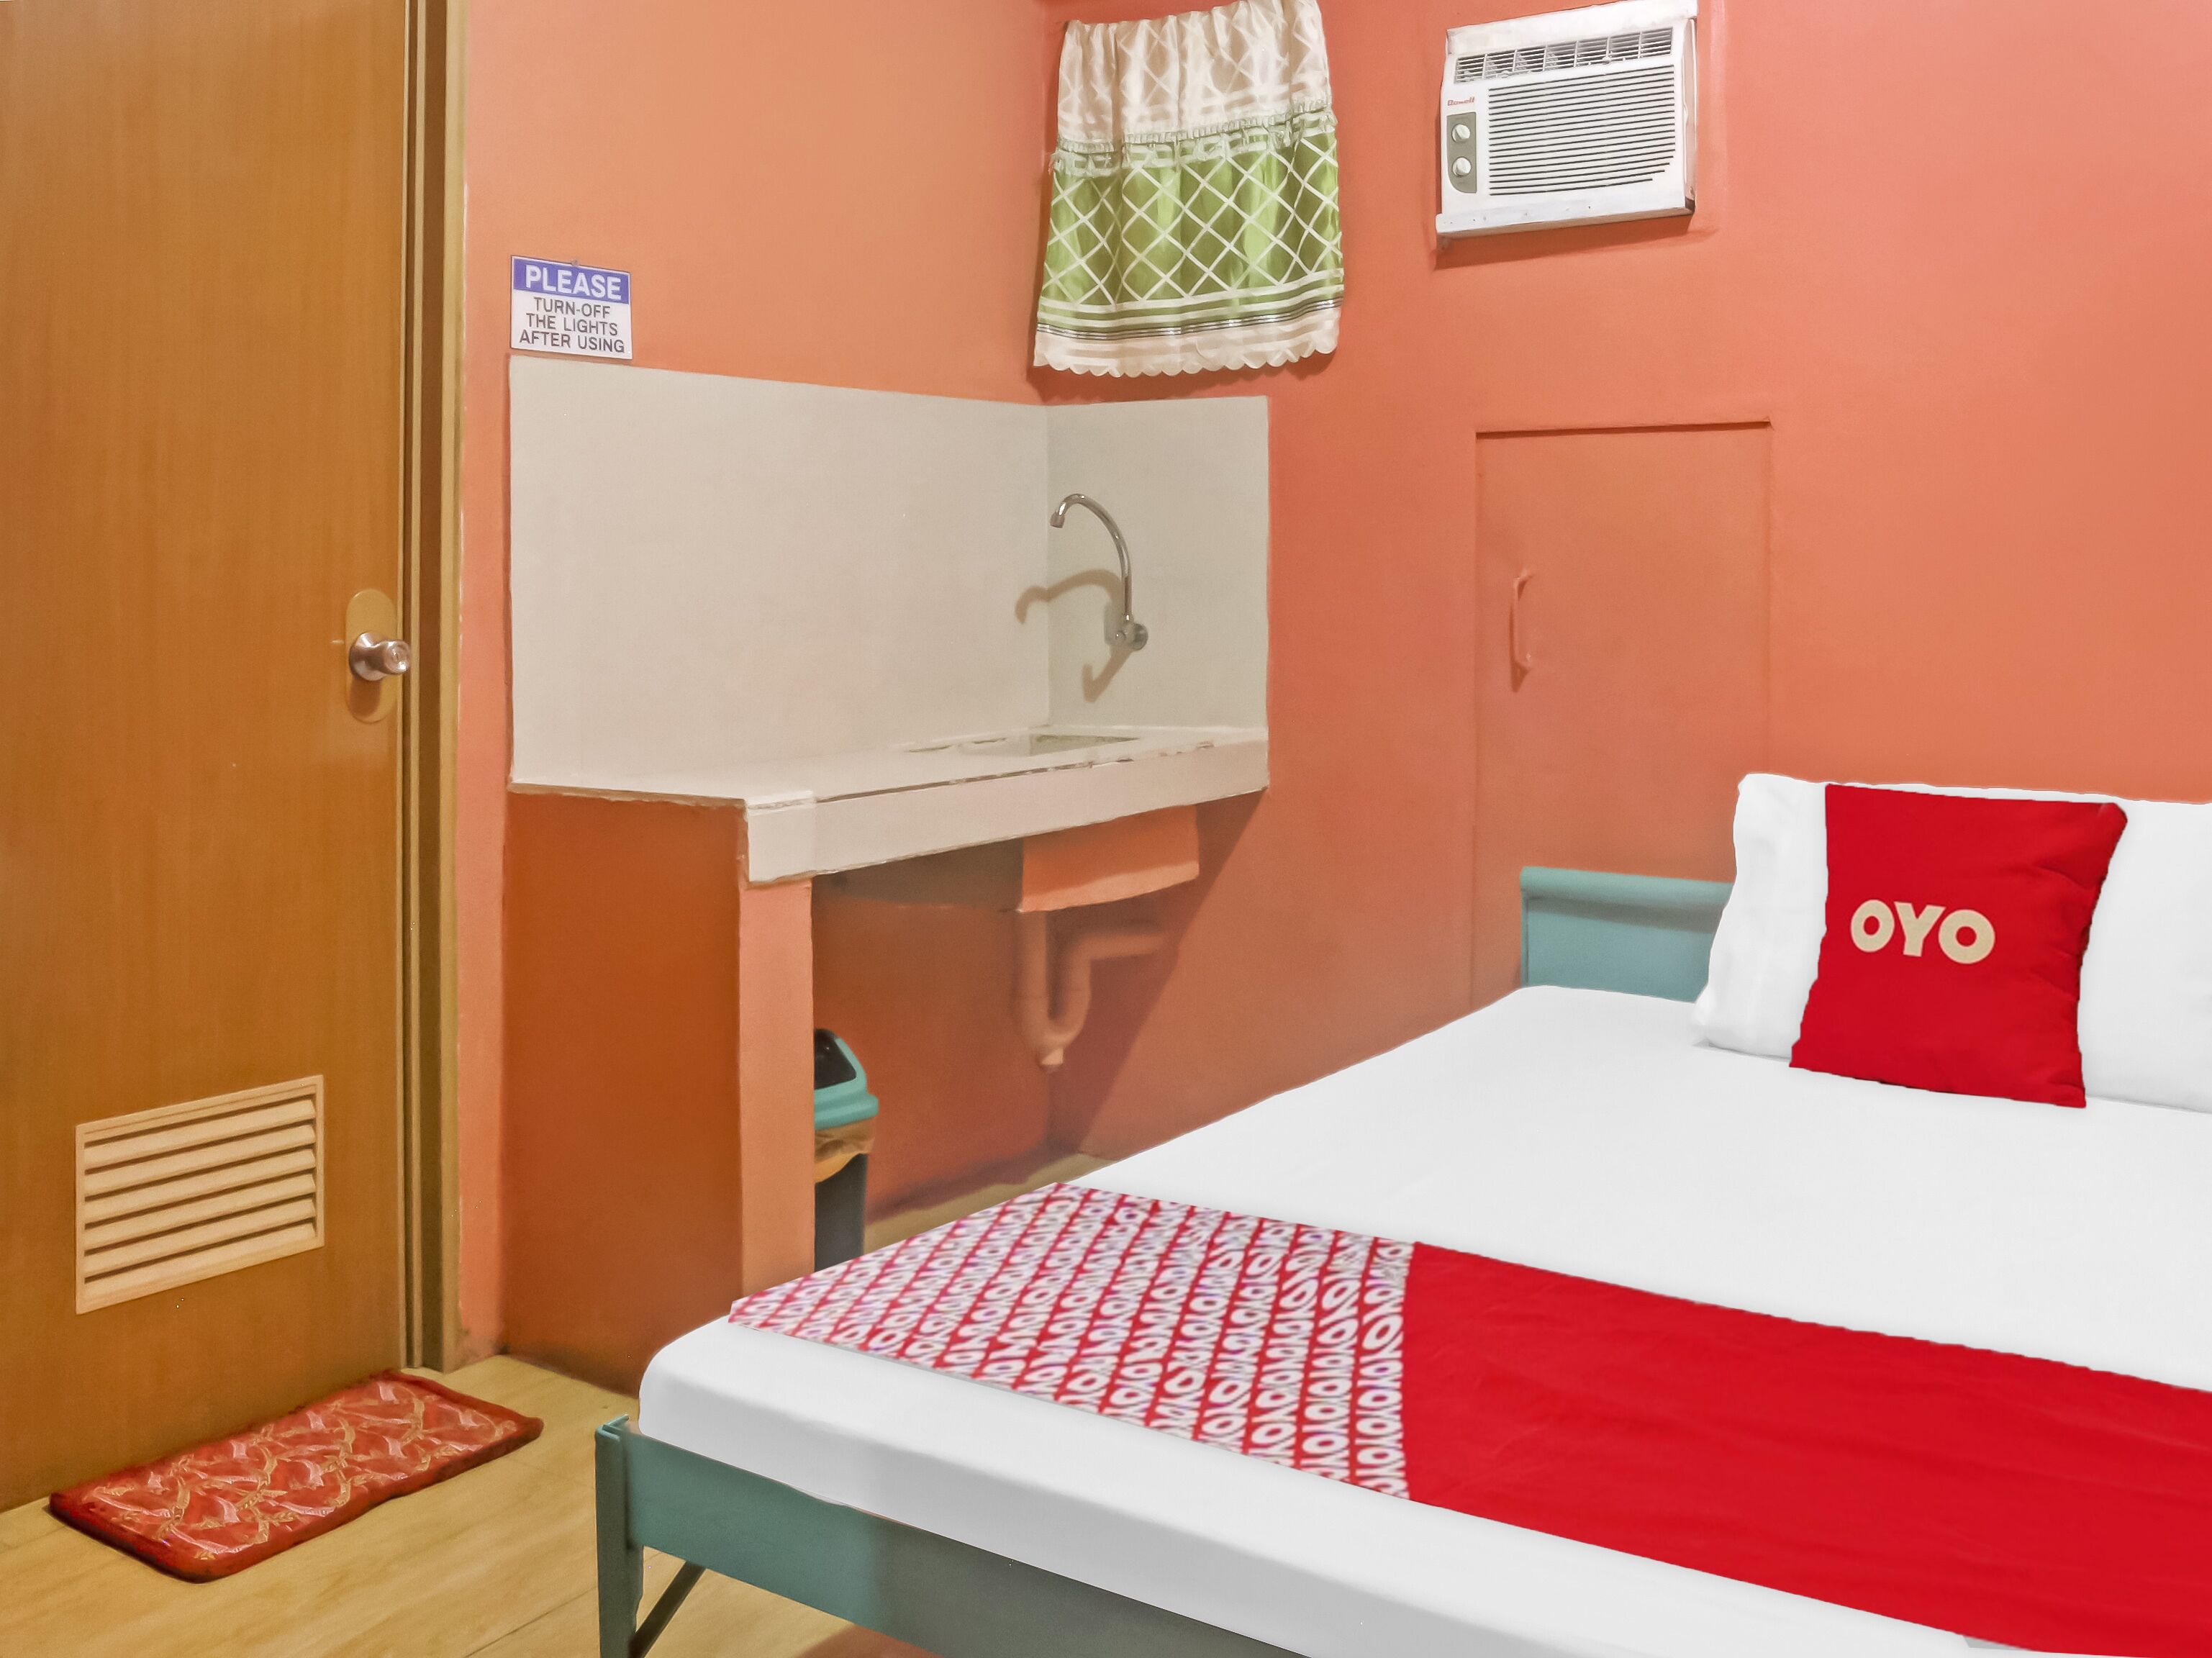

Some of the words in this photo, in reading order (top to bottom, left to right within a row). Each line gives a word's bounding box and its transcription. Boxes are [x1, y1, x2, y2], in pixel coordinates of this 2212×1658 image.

[525, 265, 622, 300] PLEASE
[533, 296, 610, 319] TURN-OFF
[526, 313, 556, 330] THE
[563, 317, 618, 336] LIGHTS
[519, 329, 571, 348] AFTER
[578, 335, 625, 353] USING
[1851, 900, 1995, 964] OYO
